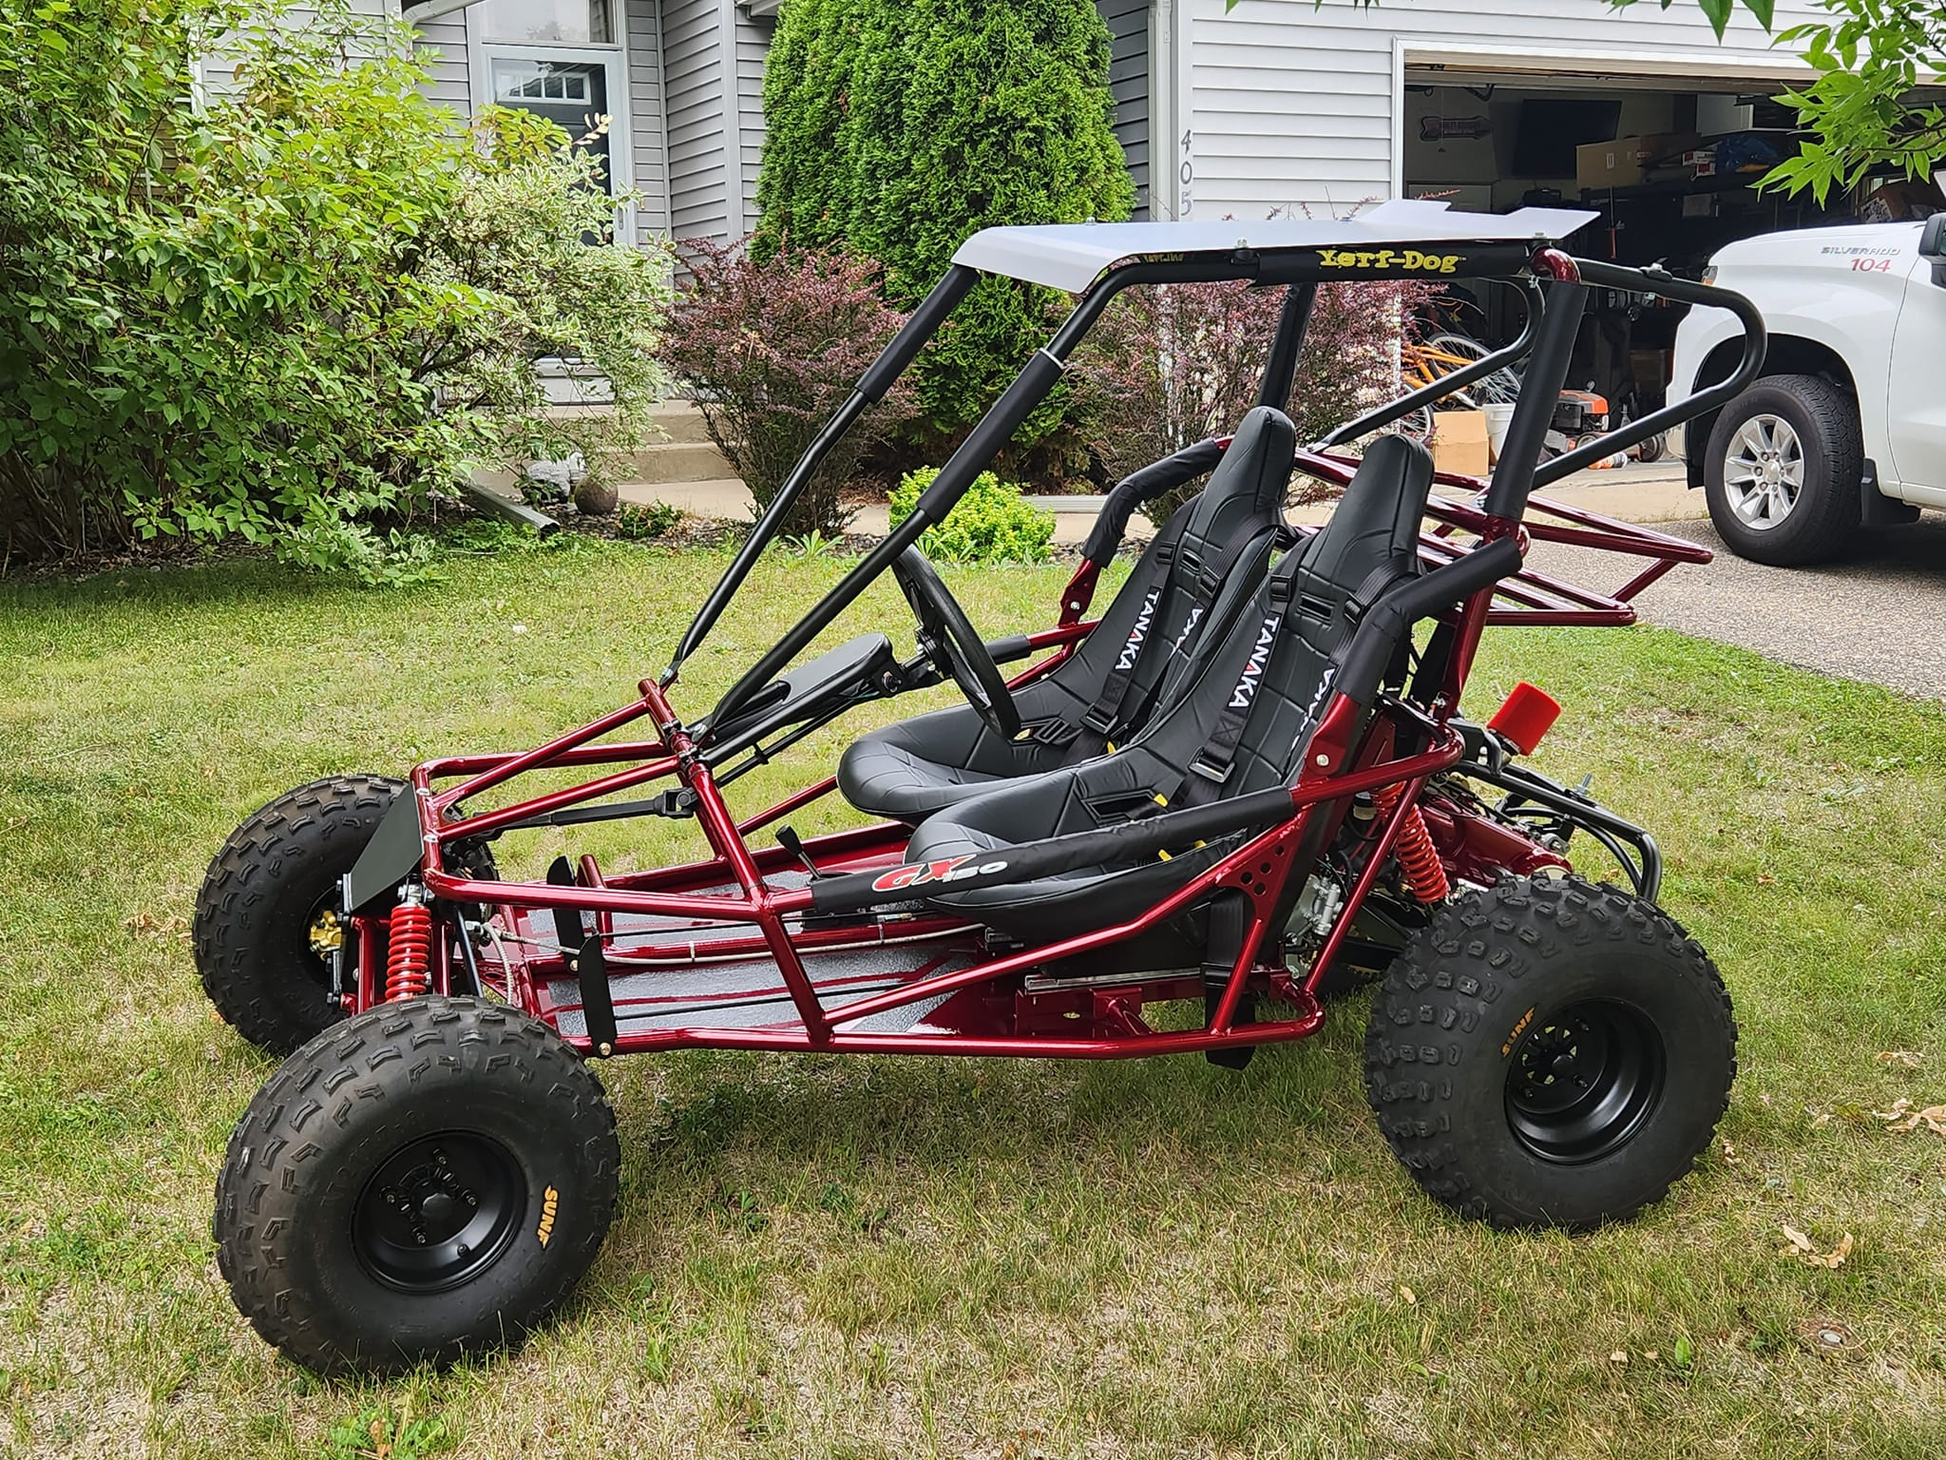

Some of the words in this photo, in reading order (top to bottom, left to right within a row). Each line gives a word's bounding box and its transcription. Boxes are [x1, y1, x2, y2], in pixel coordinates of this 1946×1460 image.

[1180, 128, 1193, 216] 405
[1820, 246, 1901, 256] SILVERADO
[1850, 258, 1891, 273] 104
[1115, 591, 1160, 670] TANAKA
[1228, 616, 1280, 707] TANAKA
[1502, 1006, 1536, 1058] SUNF
[537, 1184, 559, 1249] SUNF
